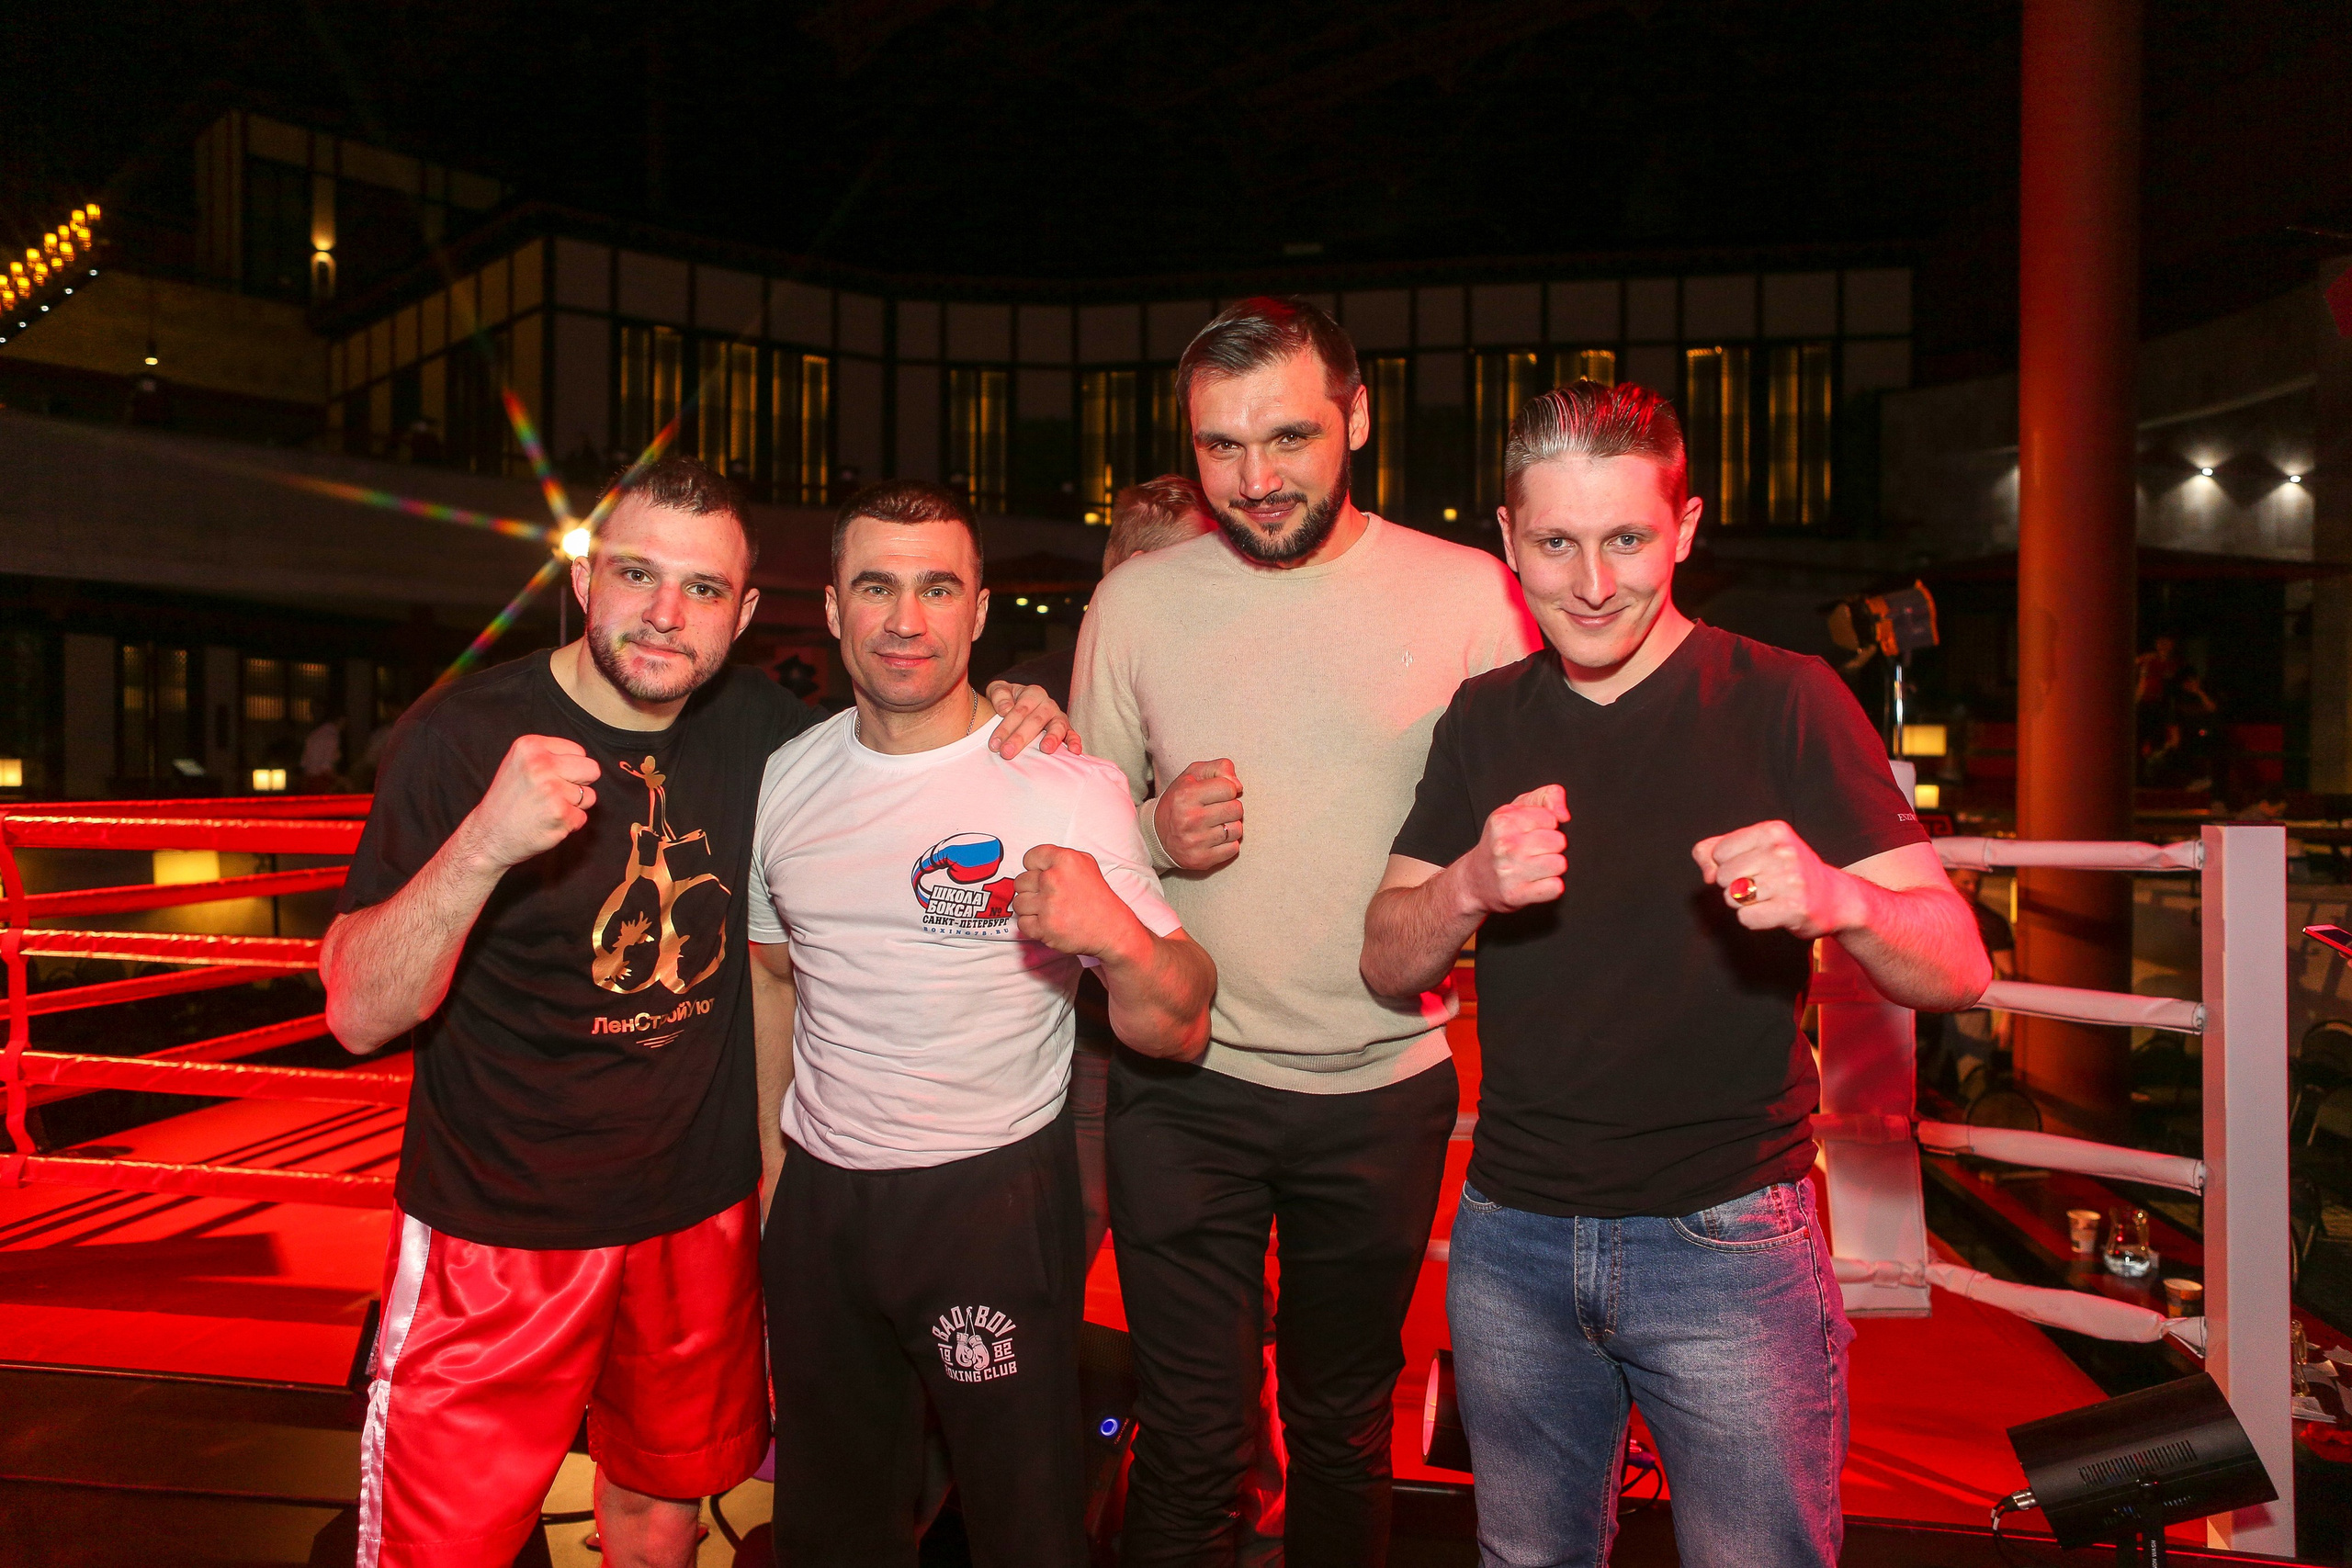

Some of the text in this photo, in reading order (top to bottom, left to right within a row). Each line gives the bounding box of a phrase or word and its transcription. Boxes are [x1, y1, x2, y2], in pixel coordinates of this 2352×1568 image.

[932, 886, 982, 906] ШКОЛА
[927, 899, 973, 918] БОКСА
[922, 915, 1010, 928] САНКТ-ПЕТЕРБУРГ
[932, 1305, 1017, 1342] BAD BOY
[993, 1341, 1012, 1359] 82
[983, 1360, 1018, 1381] CLUB
